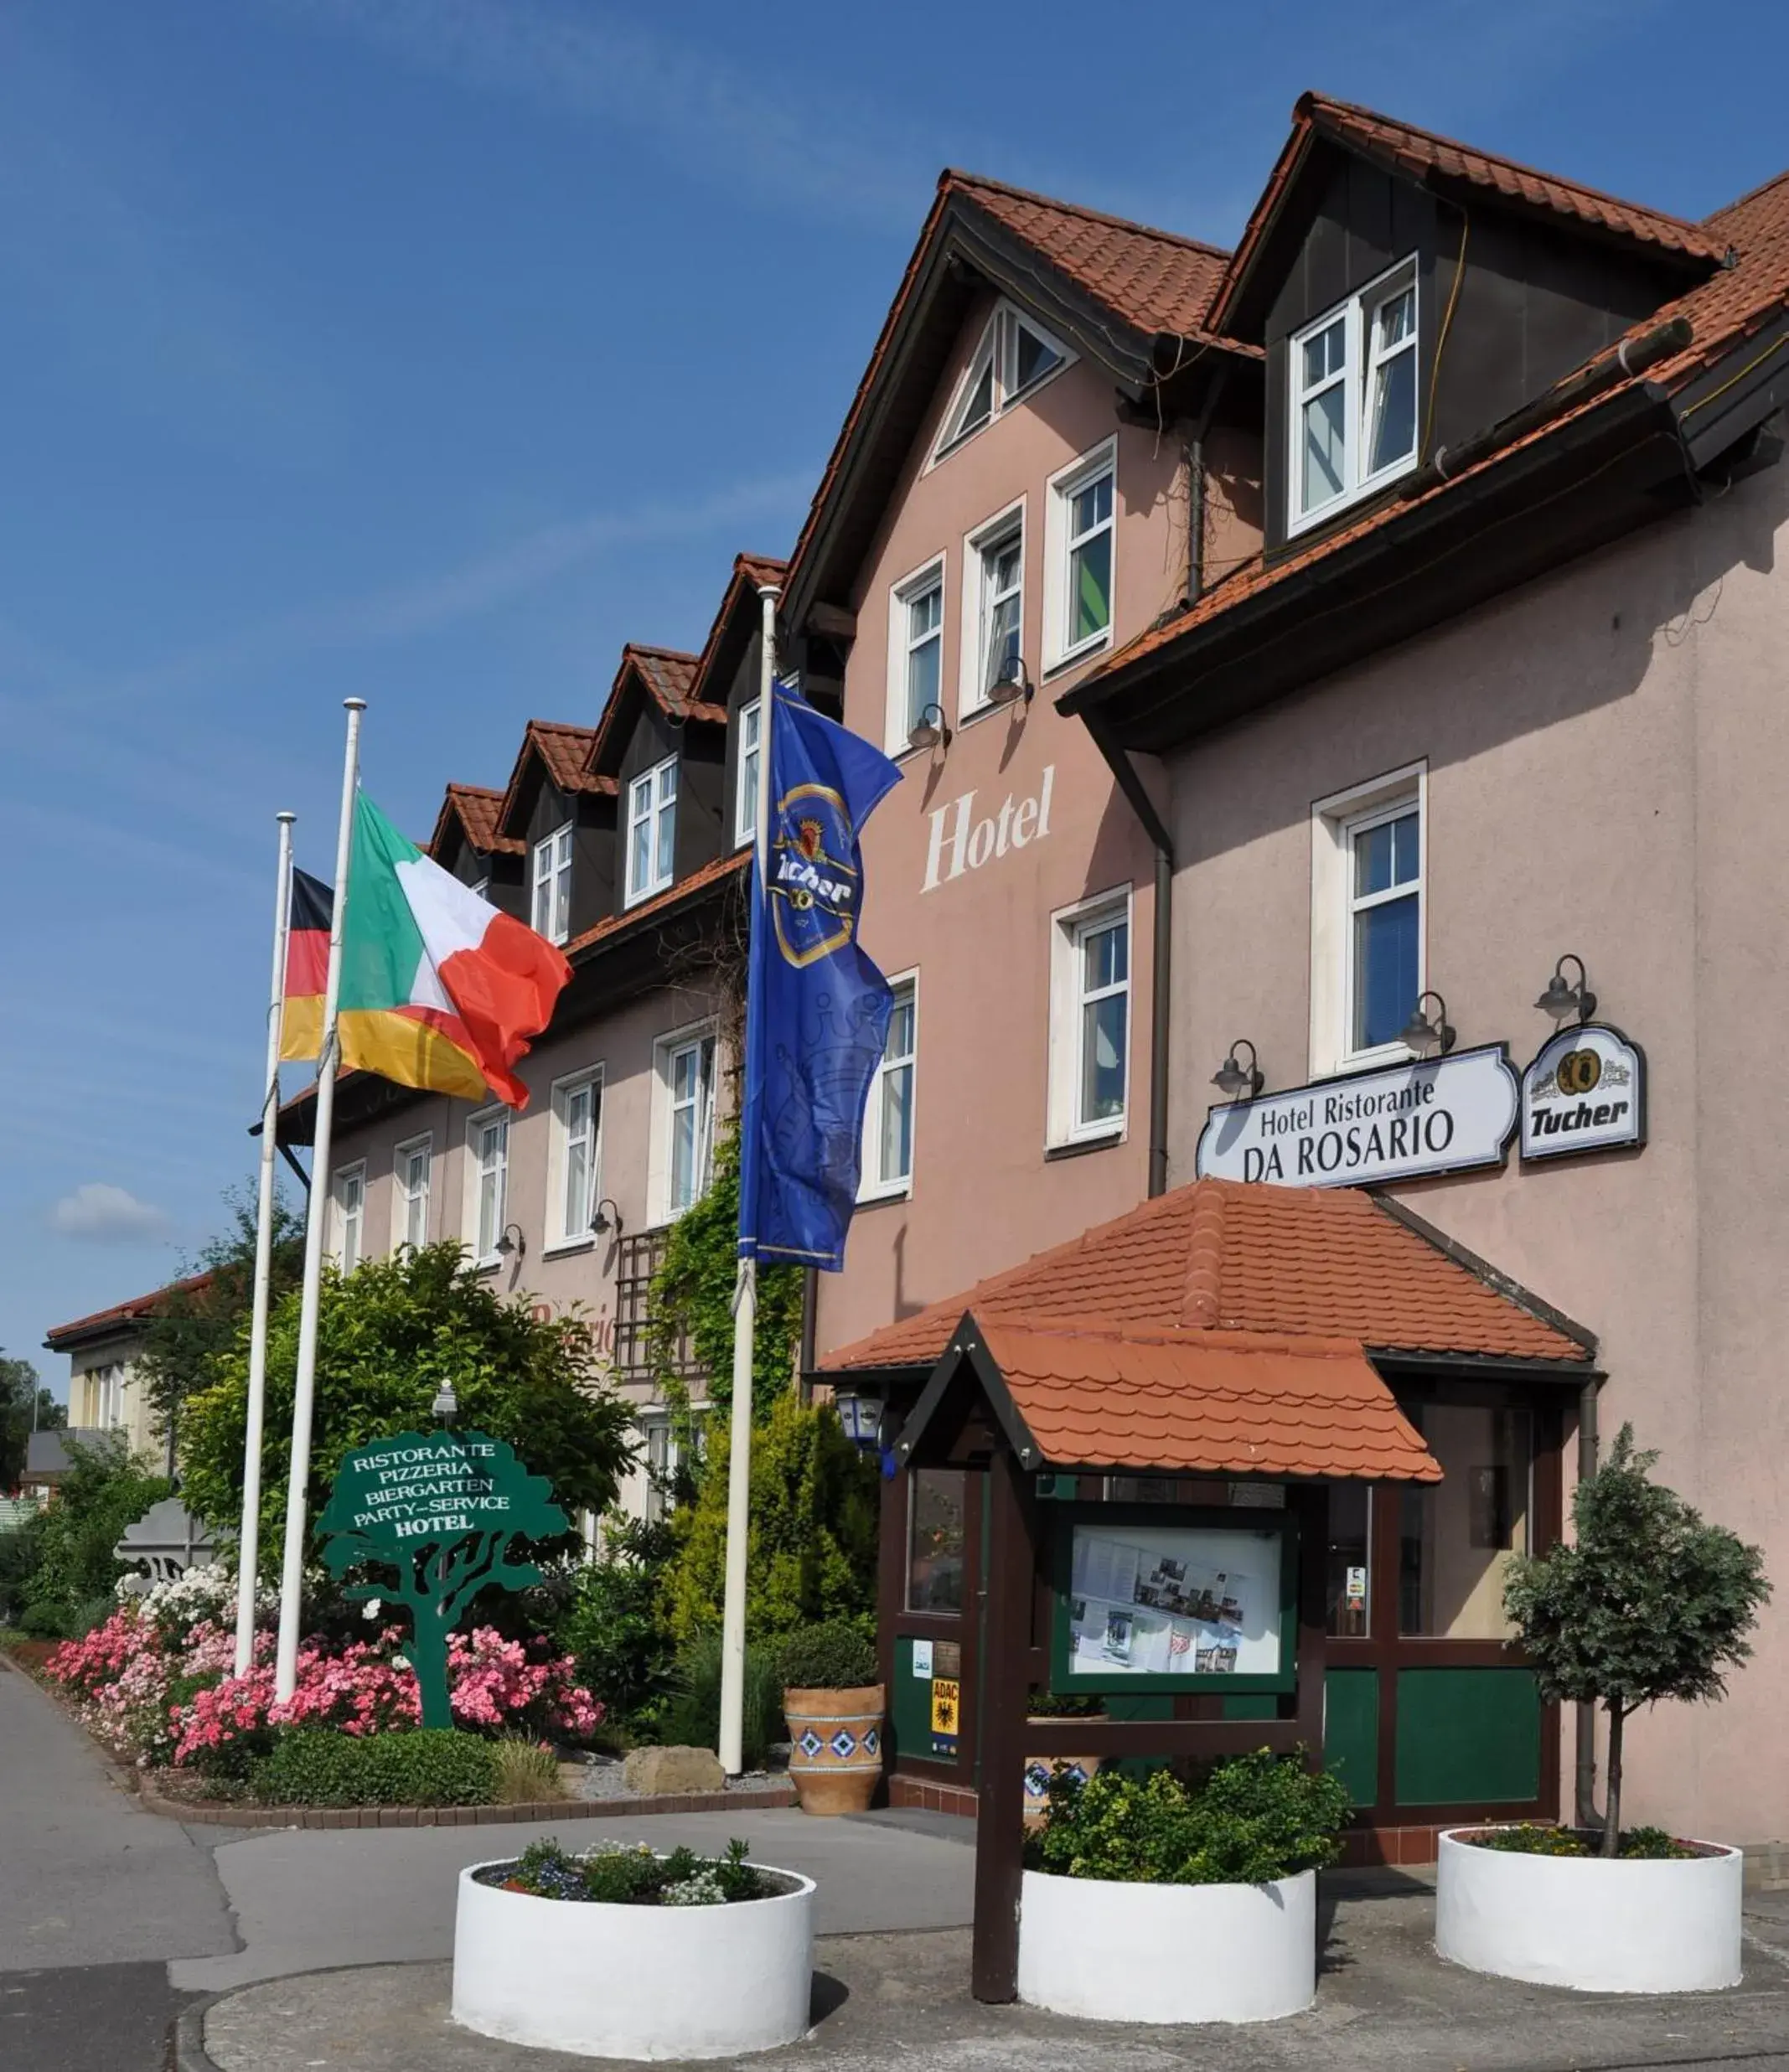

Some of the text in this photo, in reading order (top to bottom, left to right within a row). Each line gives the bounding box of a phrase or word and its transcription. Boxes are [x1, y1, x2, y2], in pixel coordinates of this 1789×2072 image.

[919, 764, 1055, 894] Hotel
[777, 853, 852, 904] cher
[1260, 1078, 1435, 1137] Hotel Ristorante
[1530, 1100, 1629, 1138] Tucher
[1244, 1108, 1455, 1183] DA ROSARIO
[353, 1444, 495, 1472] RISTORANTE
[379, 1461, 474, 1485] PIZZERIA
[365, 1478, 494, 1506] BIERGARTEN
[354, 1496, 510, 1527] PARTY-SERVICE
[395, 1514, 475, 1537] HOTEL
[934, 1682, 959, 1702] ADAC
